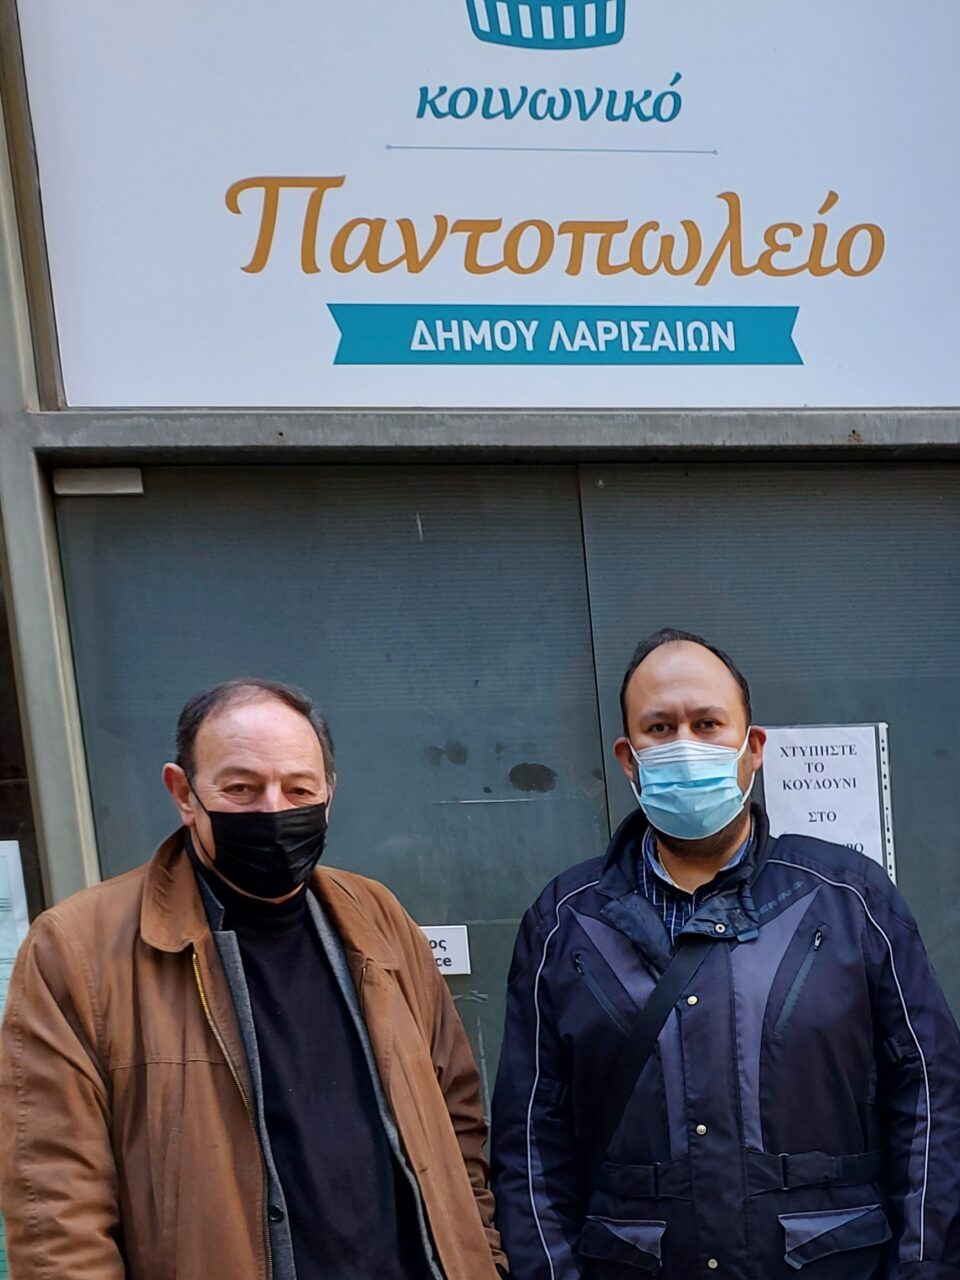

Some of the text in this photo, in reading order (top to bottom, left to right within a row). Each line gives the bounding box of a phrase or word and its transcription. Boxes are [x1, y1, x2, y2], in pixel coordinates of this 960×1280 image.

[416, 72, 682, 123] κοινωνικό
[224, 175, 885, 287] Παντοπωλείο
[410, 319, 736, 353] ΔΗΜΟΥ ΛΑΡΙΣΑΙΩΝ
[780, 744, 858, 758] ΧΤΥΠΗΣΤΕ
[804, 762, 825, 774] ΤΟ
[782, 778, 857, 791] ΚΟΥΔΟΥΝΙ
[808, 811, 837, 823] ΣΤΟ
